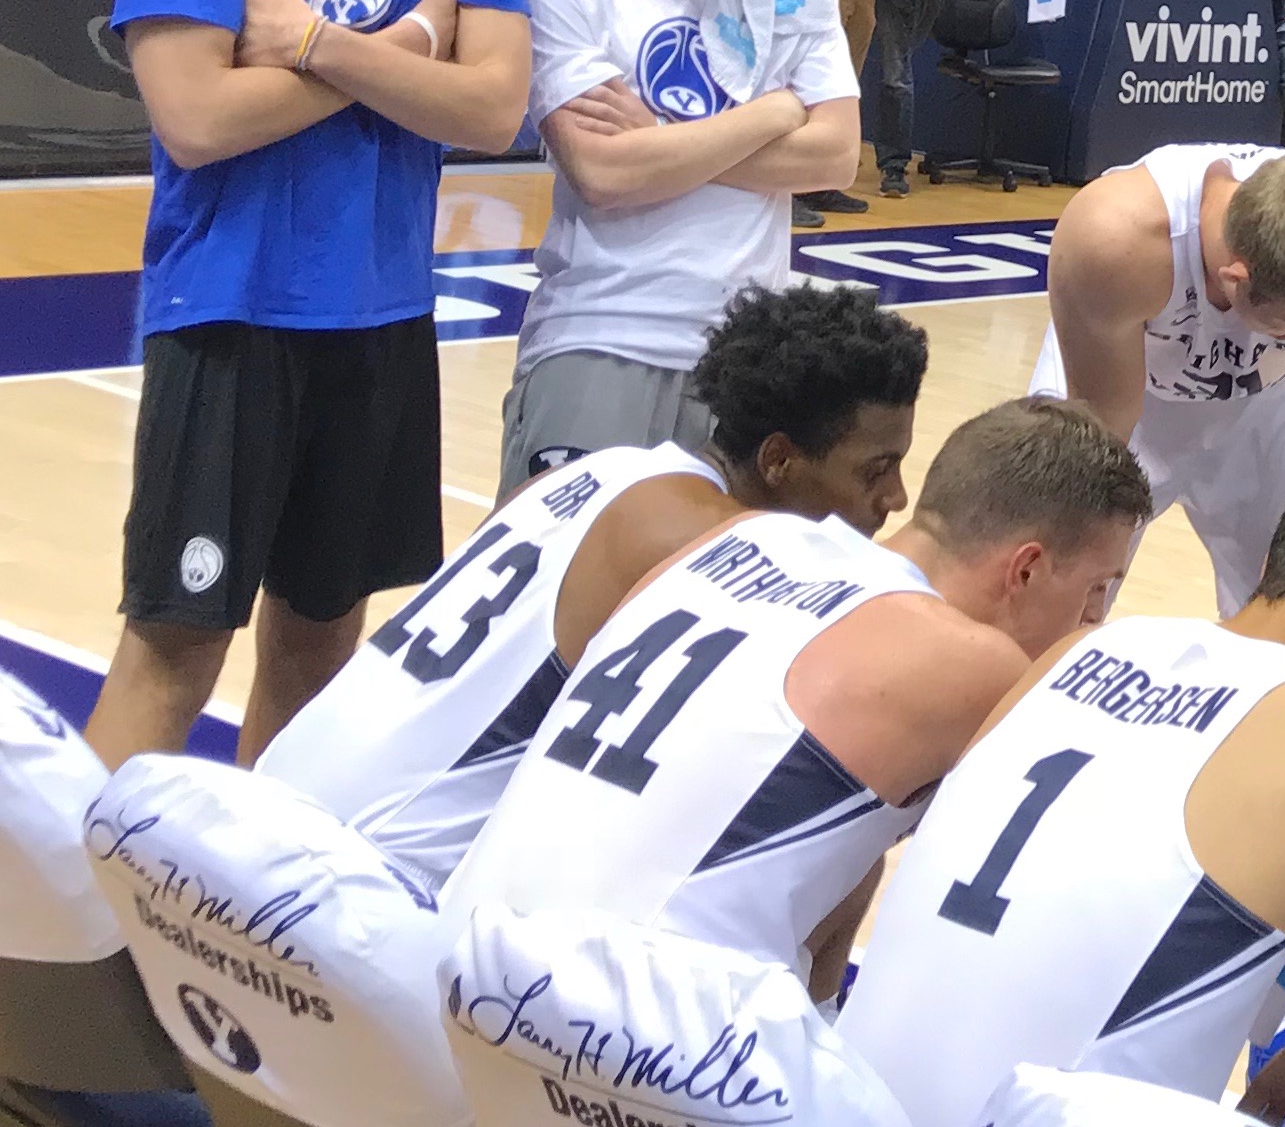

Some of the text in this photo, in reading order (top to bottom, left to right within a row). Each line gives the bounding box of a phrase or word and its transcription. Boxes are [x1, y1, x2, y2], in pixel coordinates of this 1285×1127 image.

[1118, 70, 1266, 104] SmartHome
[1125, 5, 1269, 64] vivint.
[367, 522, 543, 685] 13
[544, 608, 750, 796] 41
[1048, 648, 1240, 733] BERGERSEN
[936, 747, 1097, 937] 1
[133, 891, 335, 1024] Dealerships
